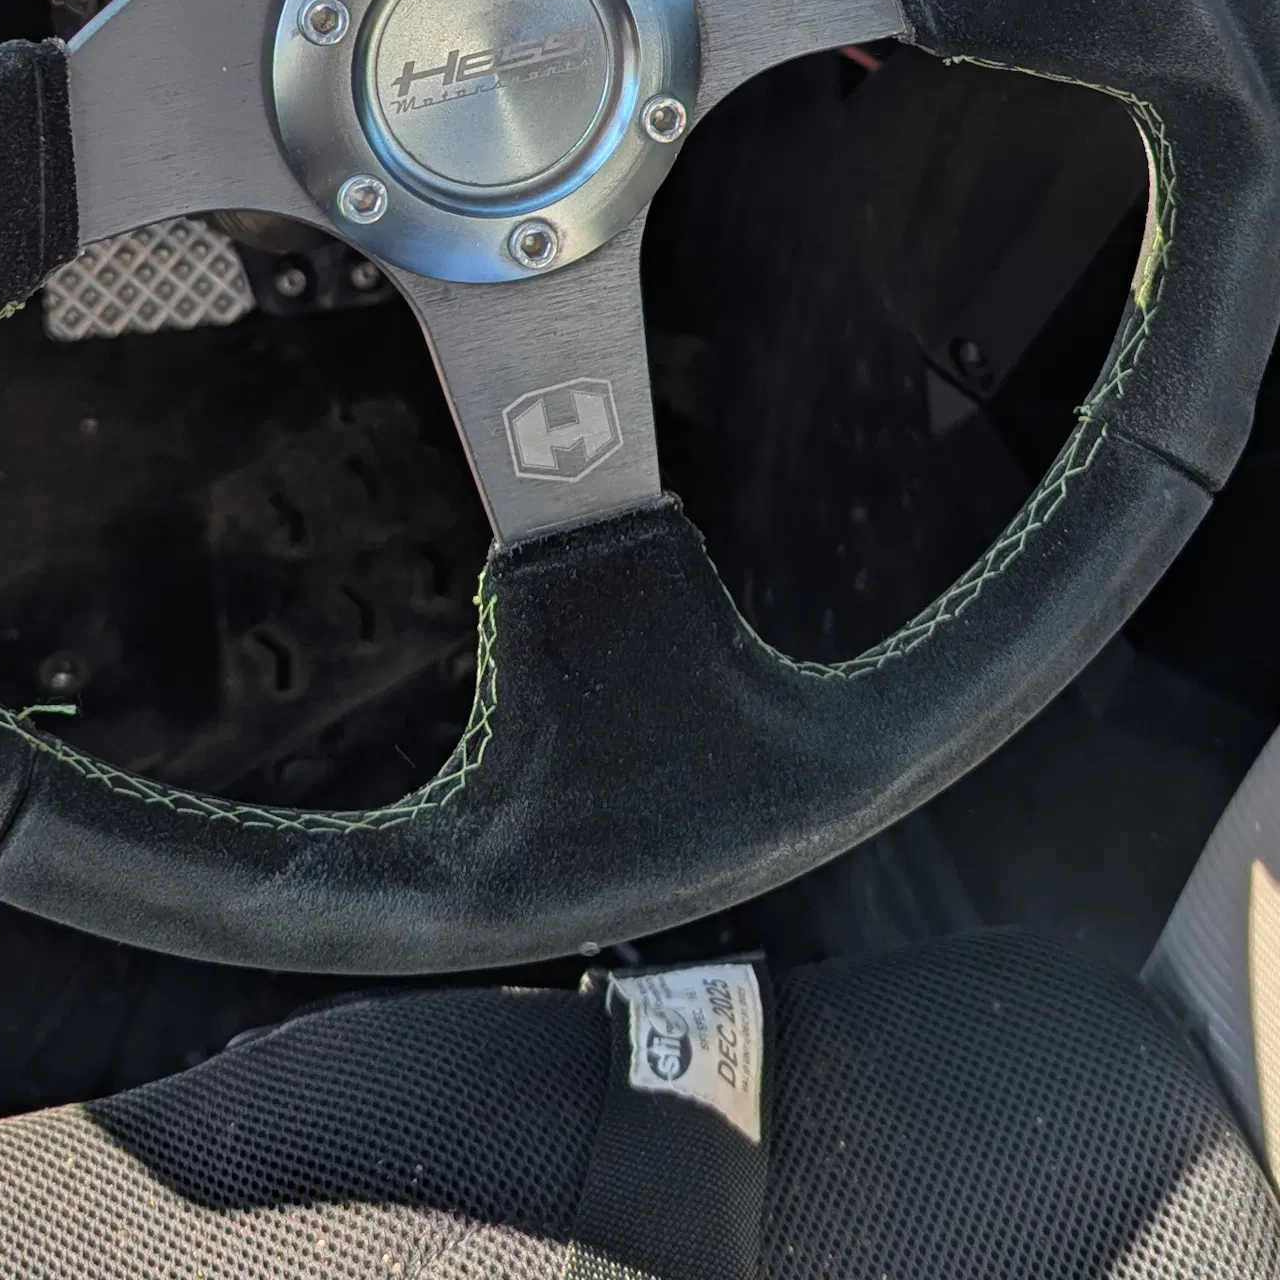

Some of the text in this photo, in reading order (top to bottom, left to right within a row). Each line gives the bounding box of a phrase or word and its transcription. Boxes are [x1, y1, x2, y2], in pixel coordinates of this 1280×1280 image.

[391, 27, 587, 97] HESS
[703, 978, 737, 1088] DEC 2025
